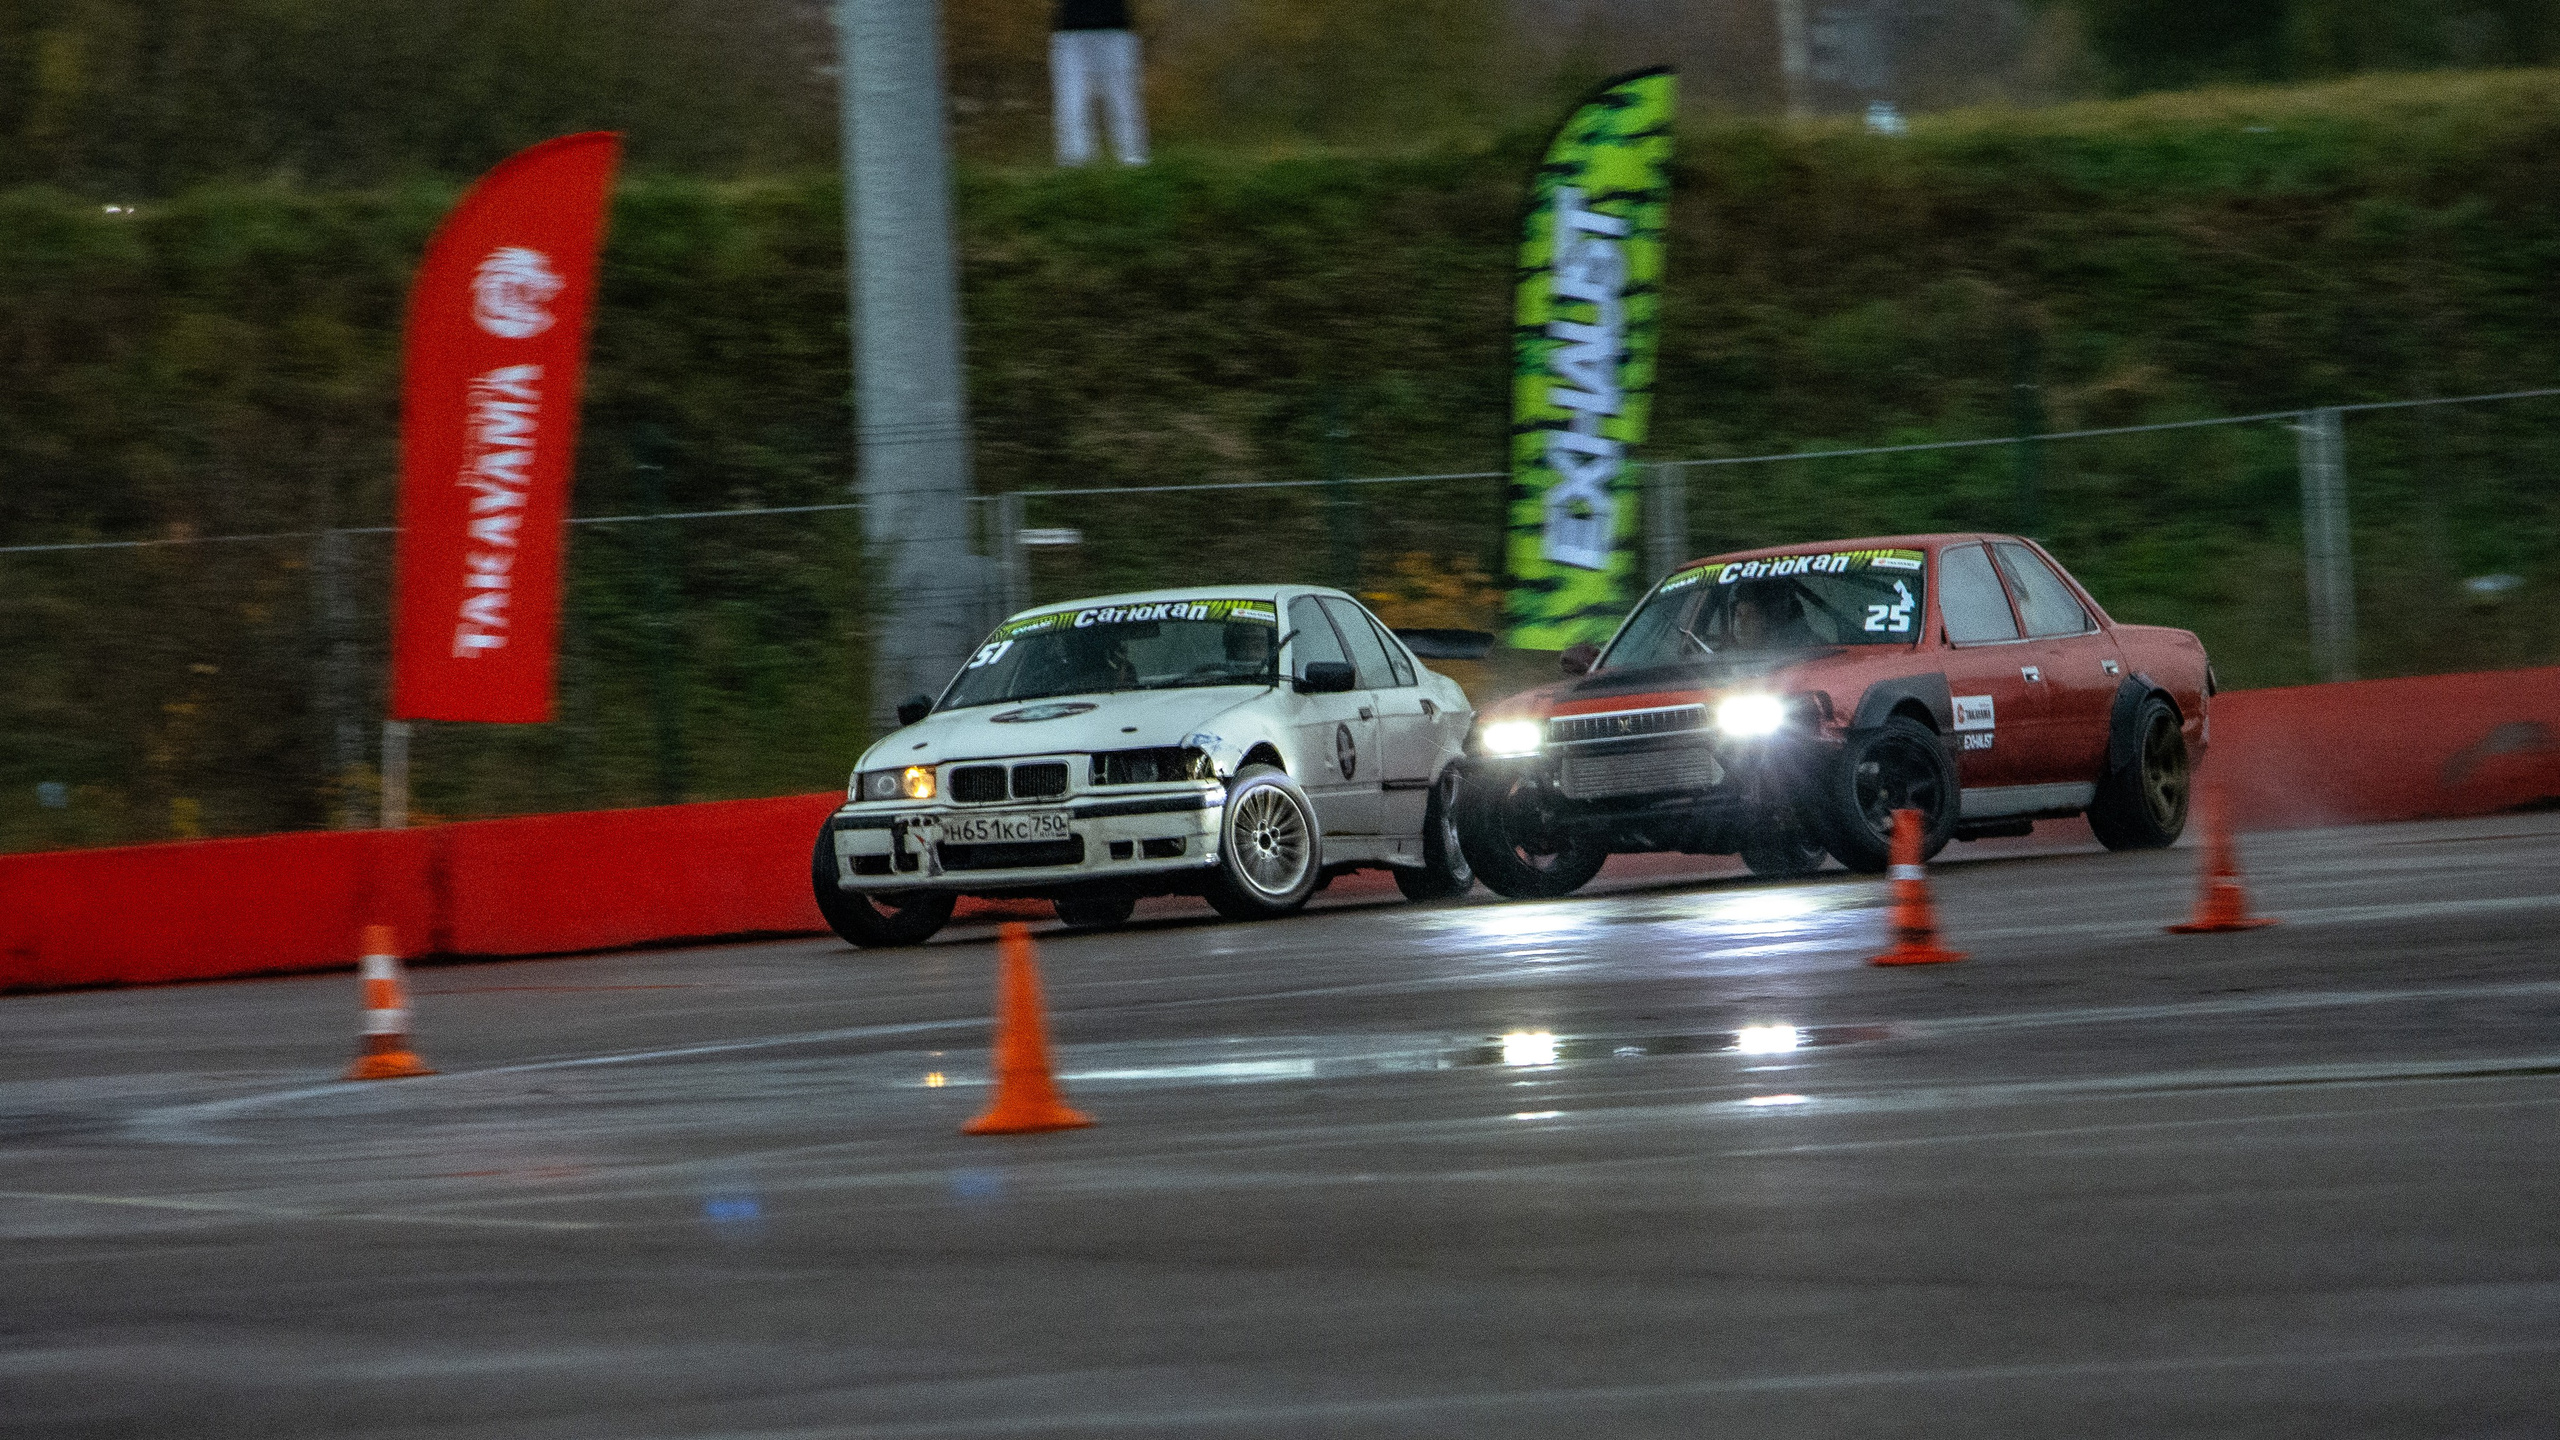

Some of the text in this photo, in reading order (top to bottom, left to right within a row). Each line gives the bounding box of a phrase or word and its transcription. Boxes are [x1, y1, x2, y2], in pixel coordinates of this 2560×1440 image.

[1543, 185, 1634, 571] EXHAUST
[452, 364, 546, 659] TAKAYAMA
[1864, 604, 1911, 632] 25
[968, 639, 1015, 669] 51
[1031, 815, 1063, 832] 750
